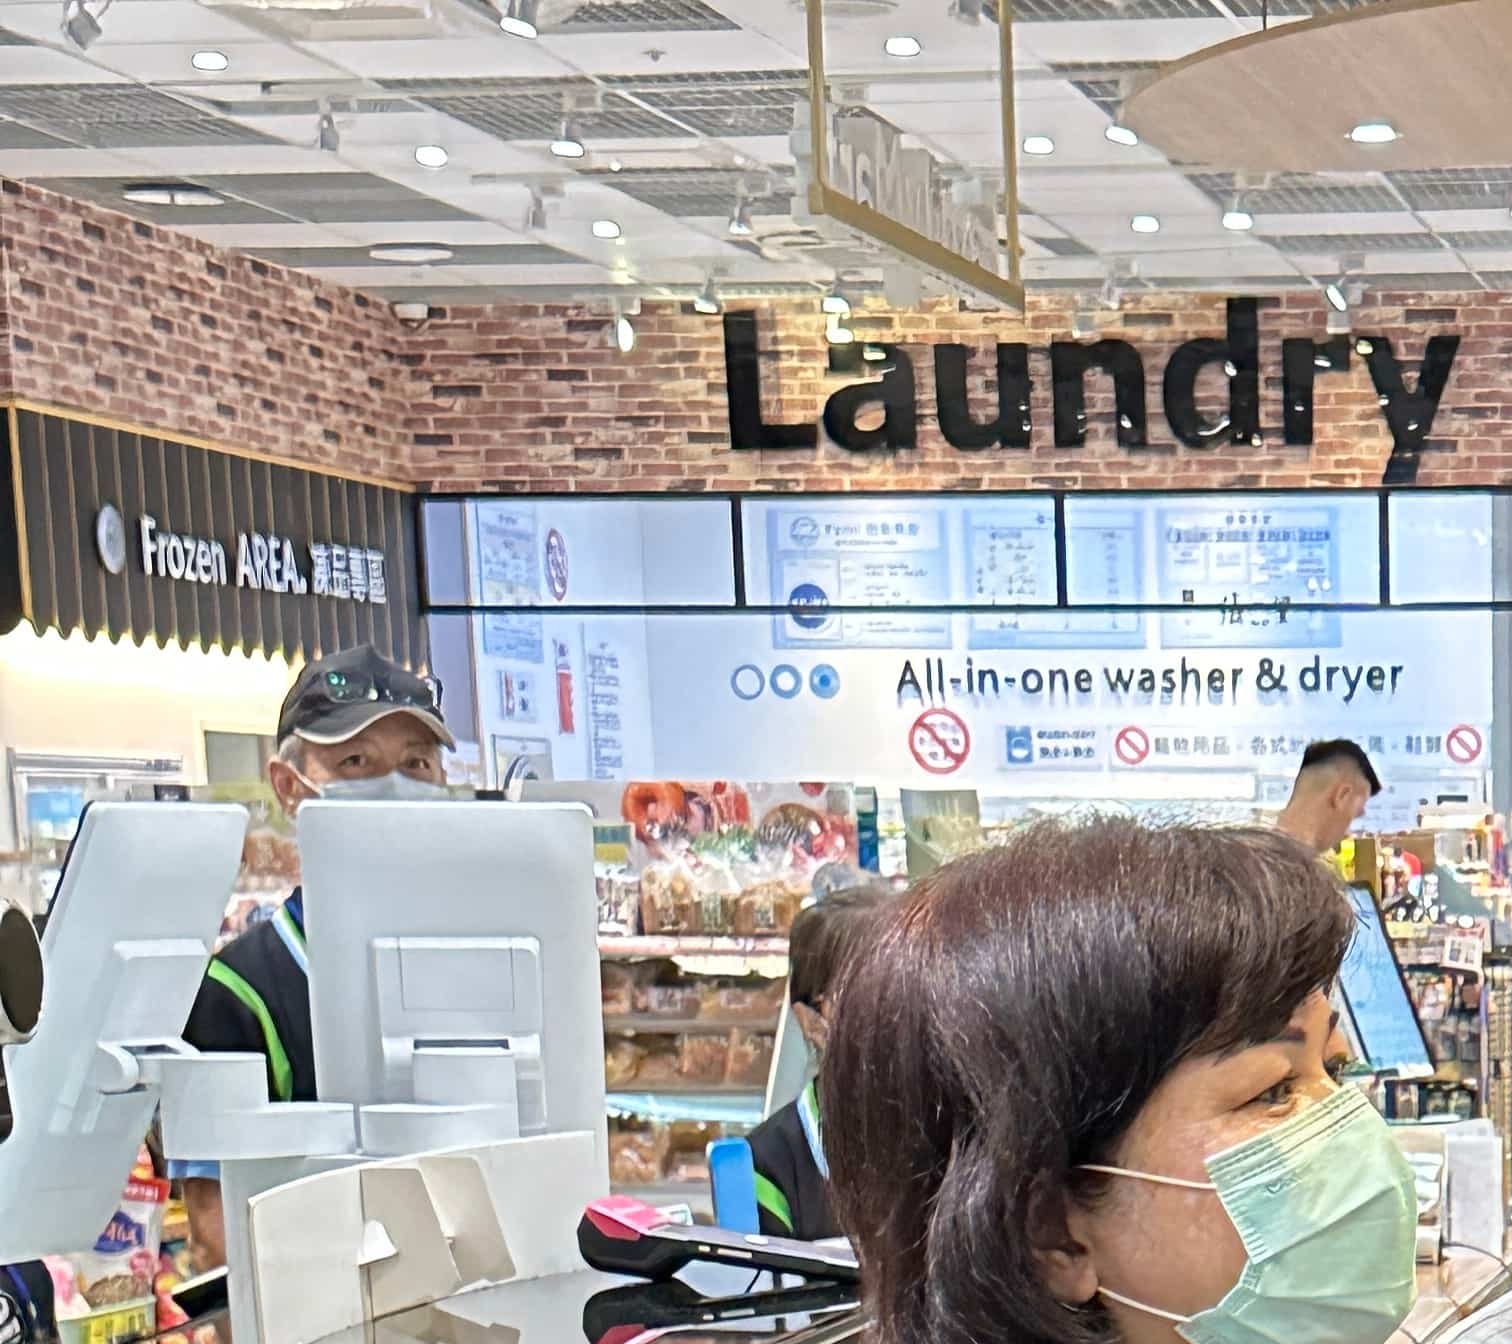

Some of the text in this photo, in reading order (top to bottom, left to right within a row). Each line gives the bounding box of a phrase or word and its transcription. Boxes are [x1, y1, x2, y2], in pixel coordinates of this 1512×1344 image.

[722, 296, 1460, 485] Laundry
[140, 514, 226, 585] Frozen
[897, 655, 1404, 704] All-in-one washer & dryer
